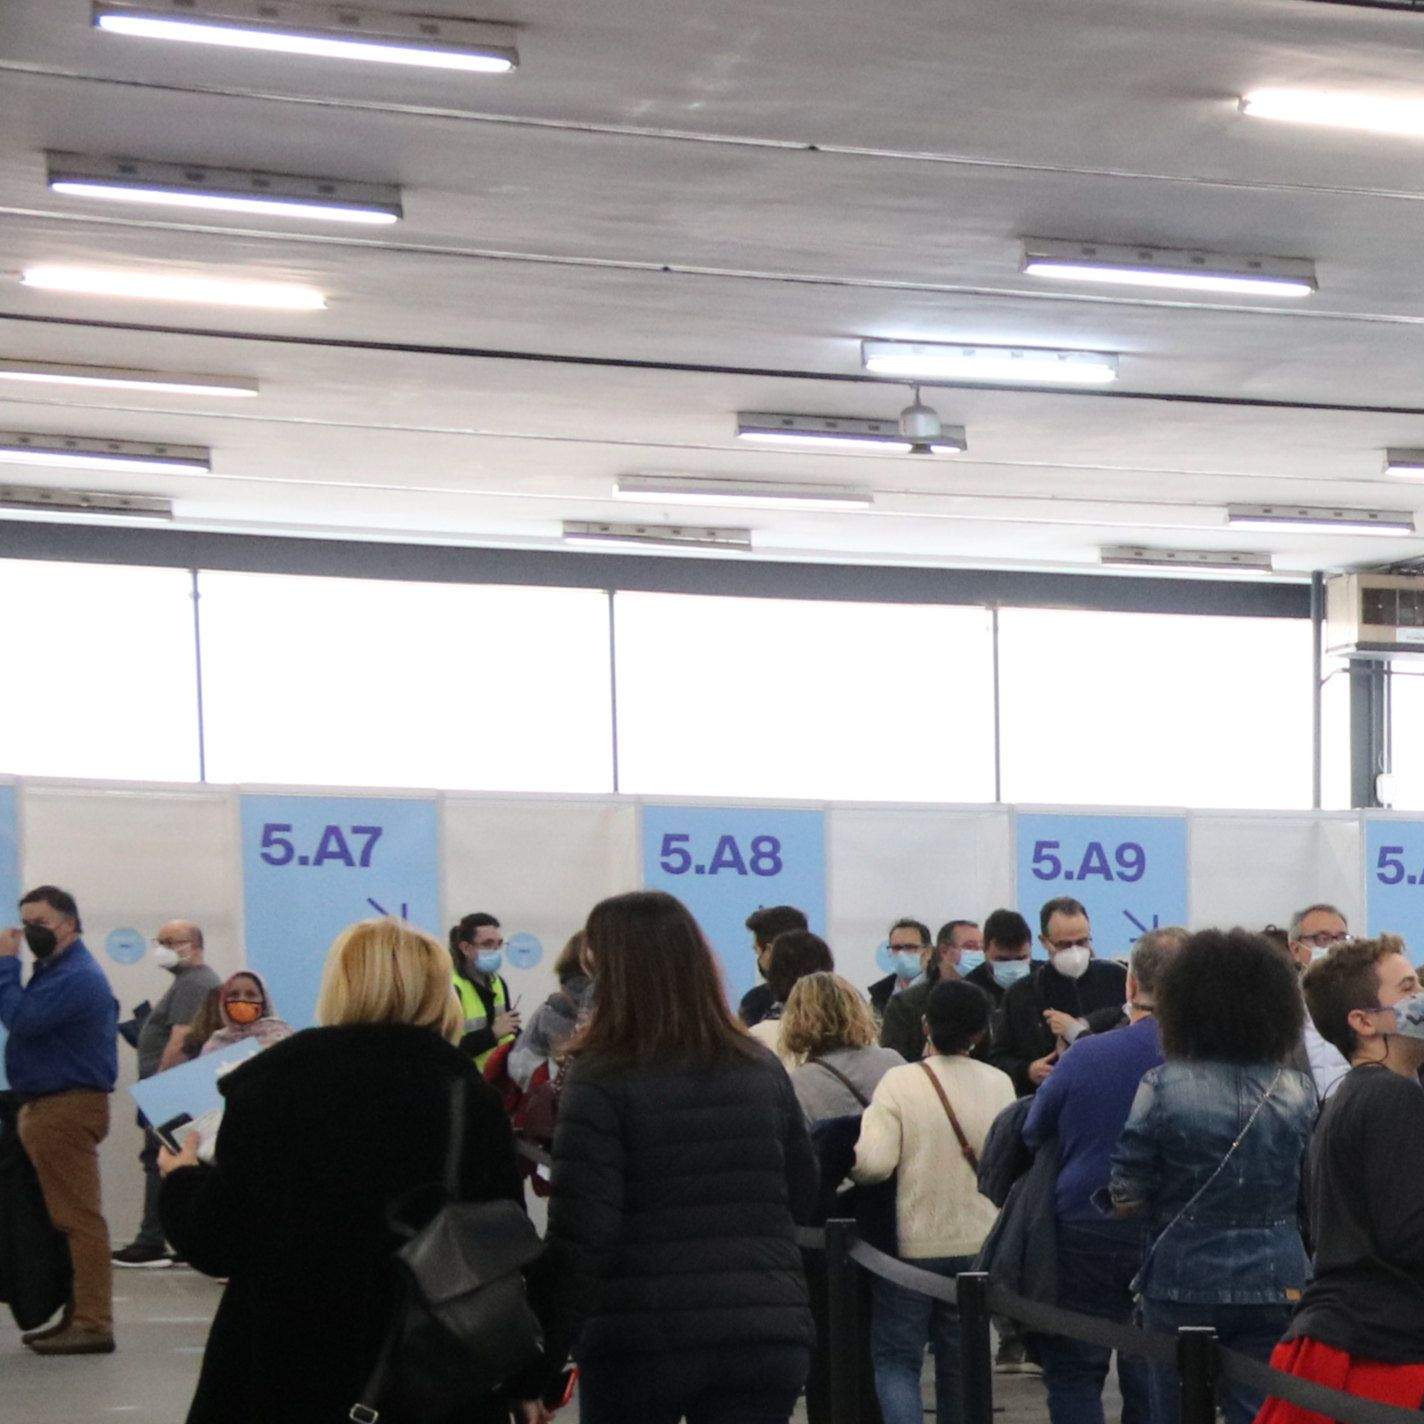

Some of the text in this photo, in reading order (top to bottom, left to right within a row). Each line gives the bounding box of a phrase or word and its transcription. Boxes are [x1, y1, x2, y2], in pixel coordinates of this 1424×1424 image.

[261, 824, 381, 867] 5.A7
[661, 834, 781, 876] 5.A8
[1032, 841, 1145, 882] 5.A9
